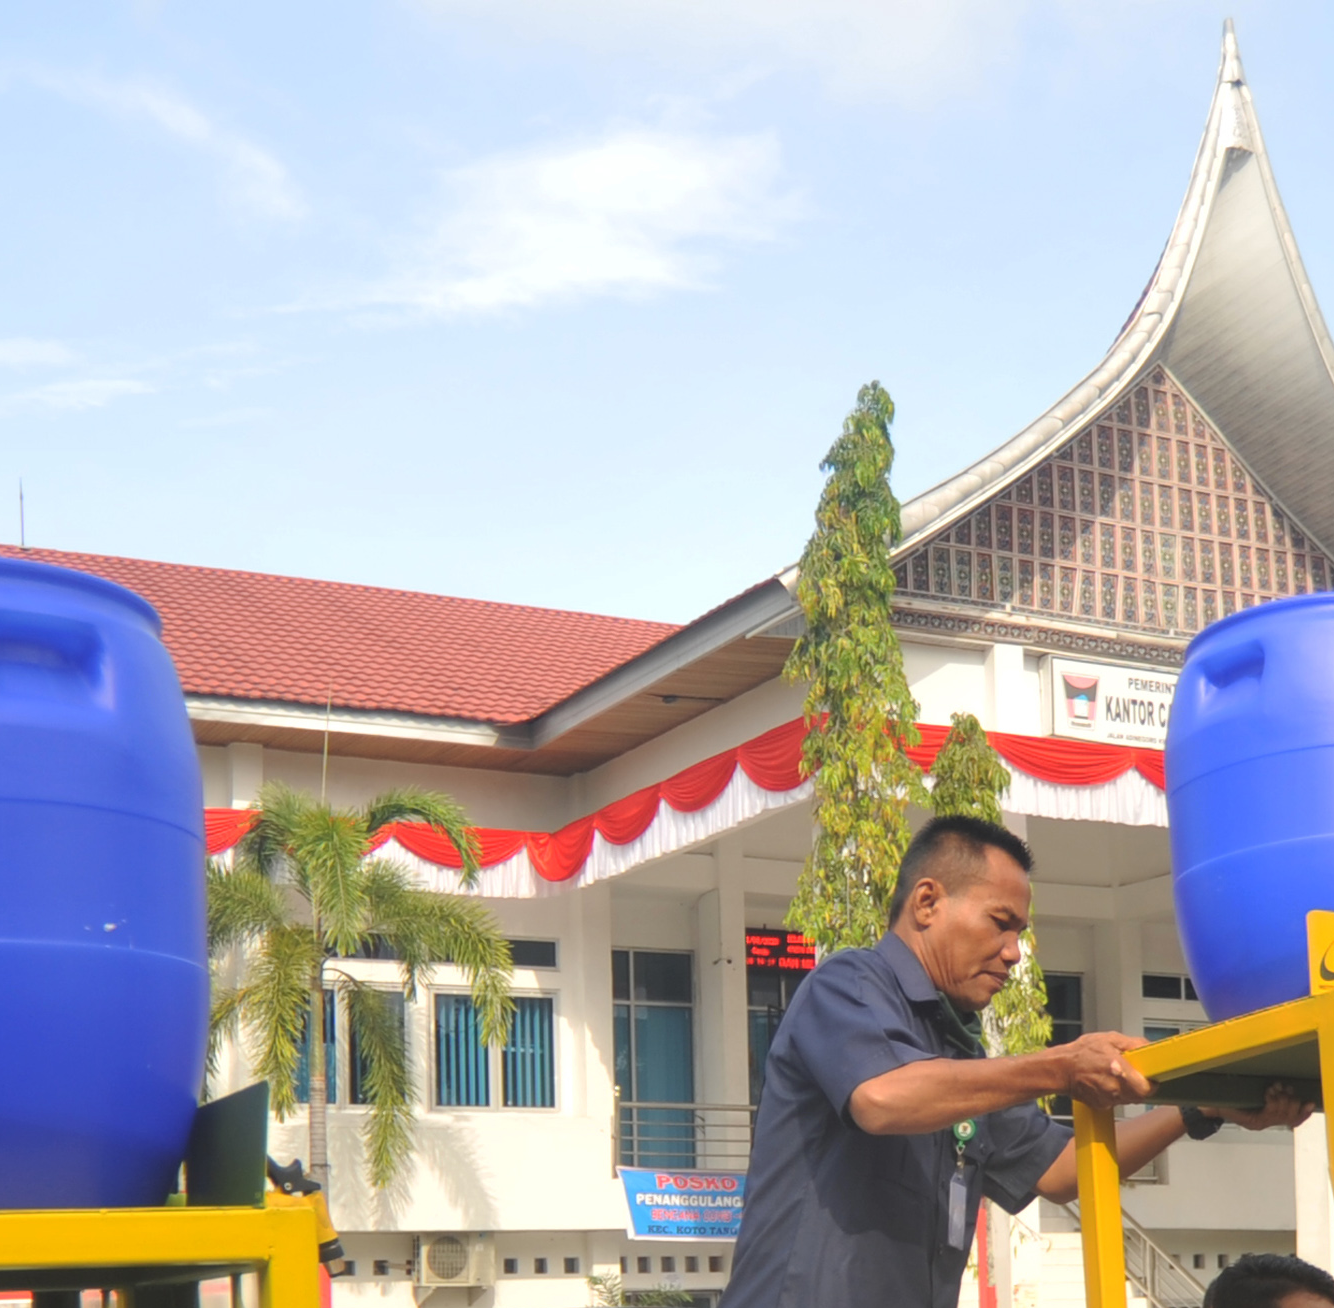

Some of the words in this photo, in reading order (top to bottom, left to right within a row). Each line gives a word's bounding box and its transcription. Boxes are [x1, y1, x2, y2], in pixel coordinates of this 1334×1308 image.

[1105, 695, 1155, 727] KANTOR
[1158, 702, 1172, 728] C
[655, 1174, 738, 1192] POSKO
[651, 1208, 700, 1222] BENCANA
[647, 1225, 673, 1235] KEC.
[676, 1226, 707, 1235] KOTO
